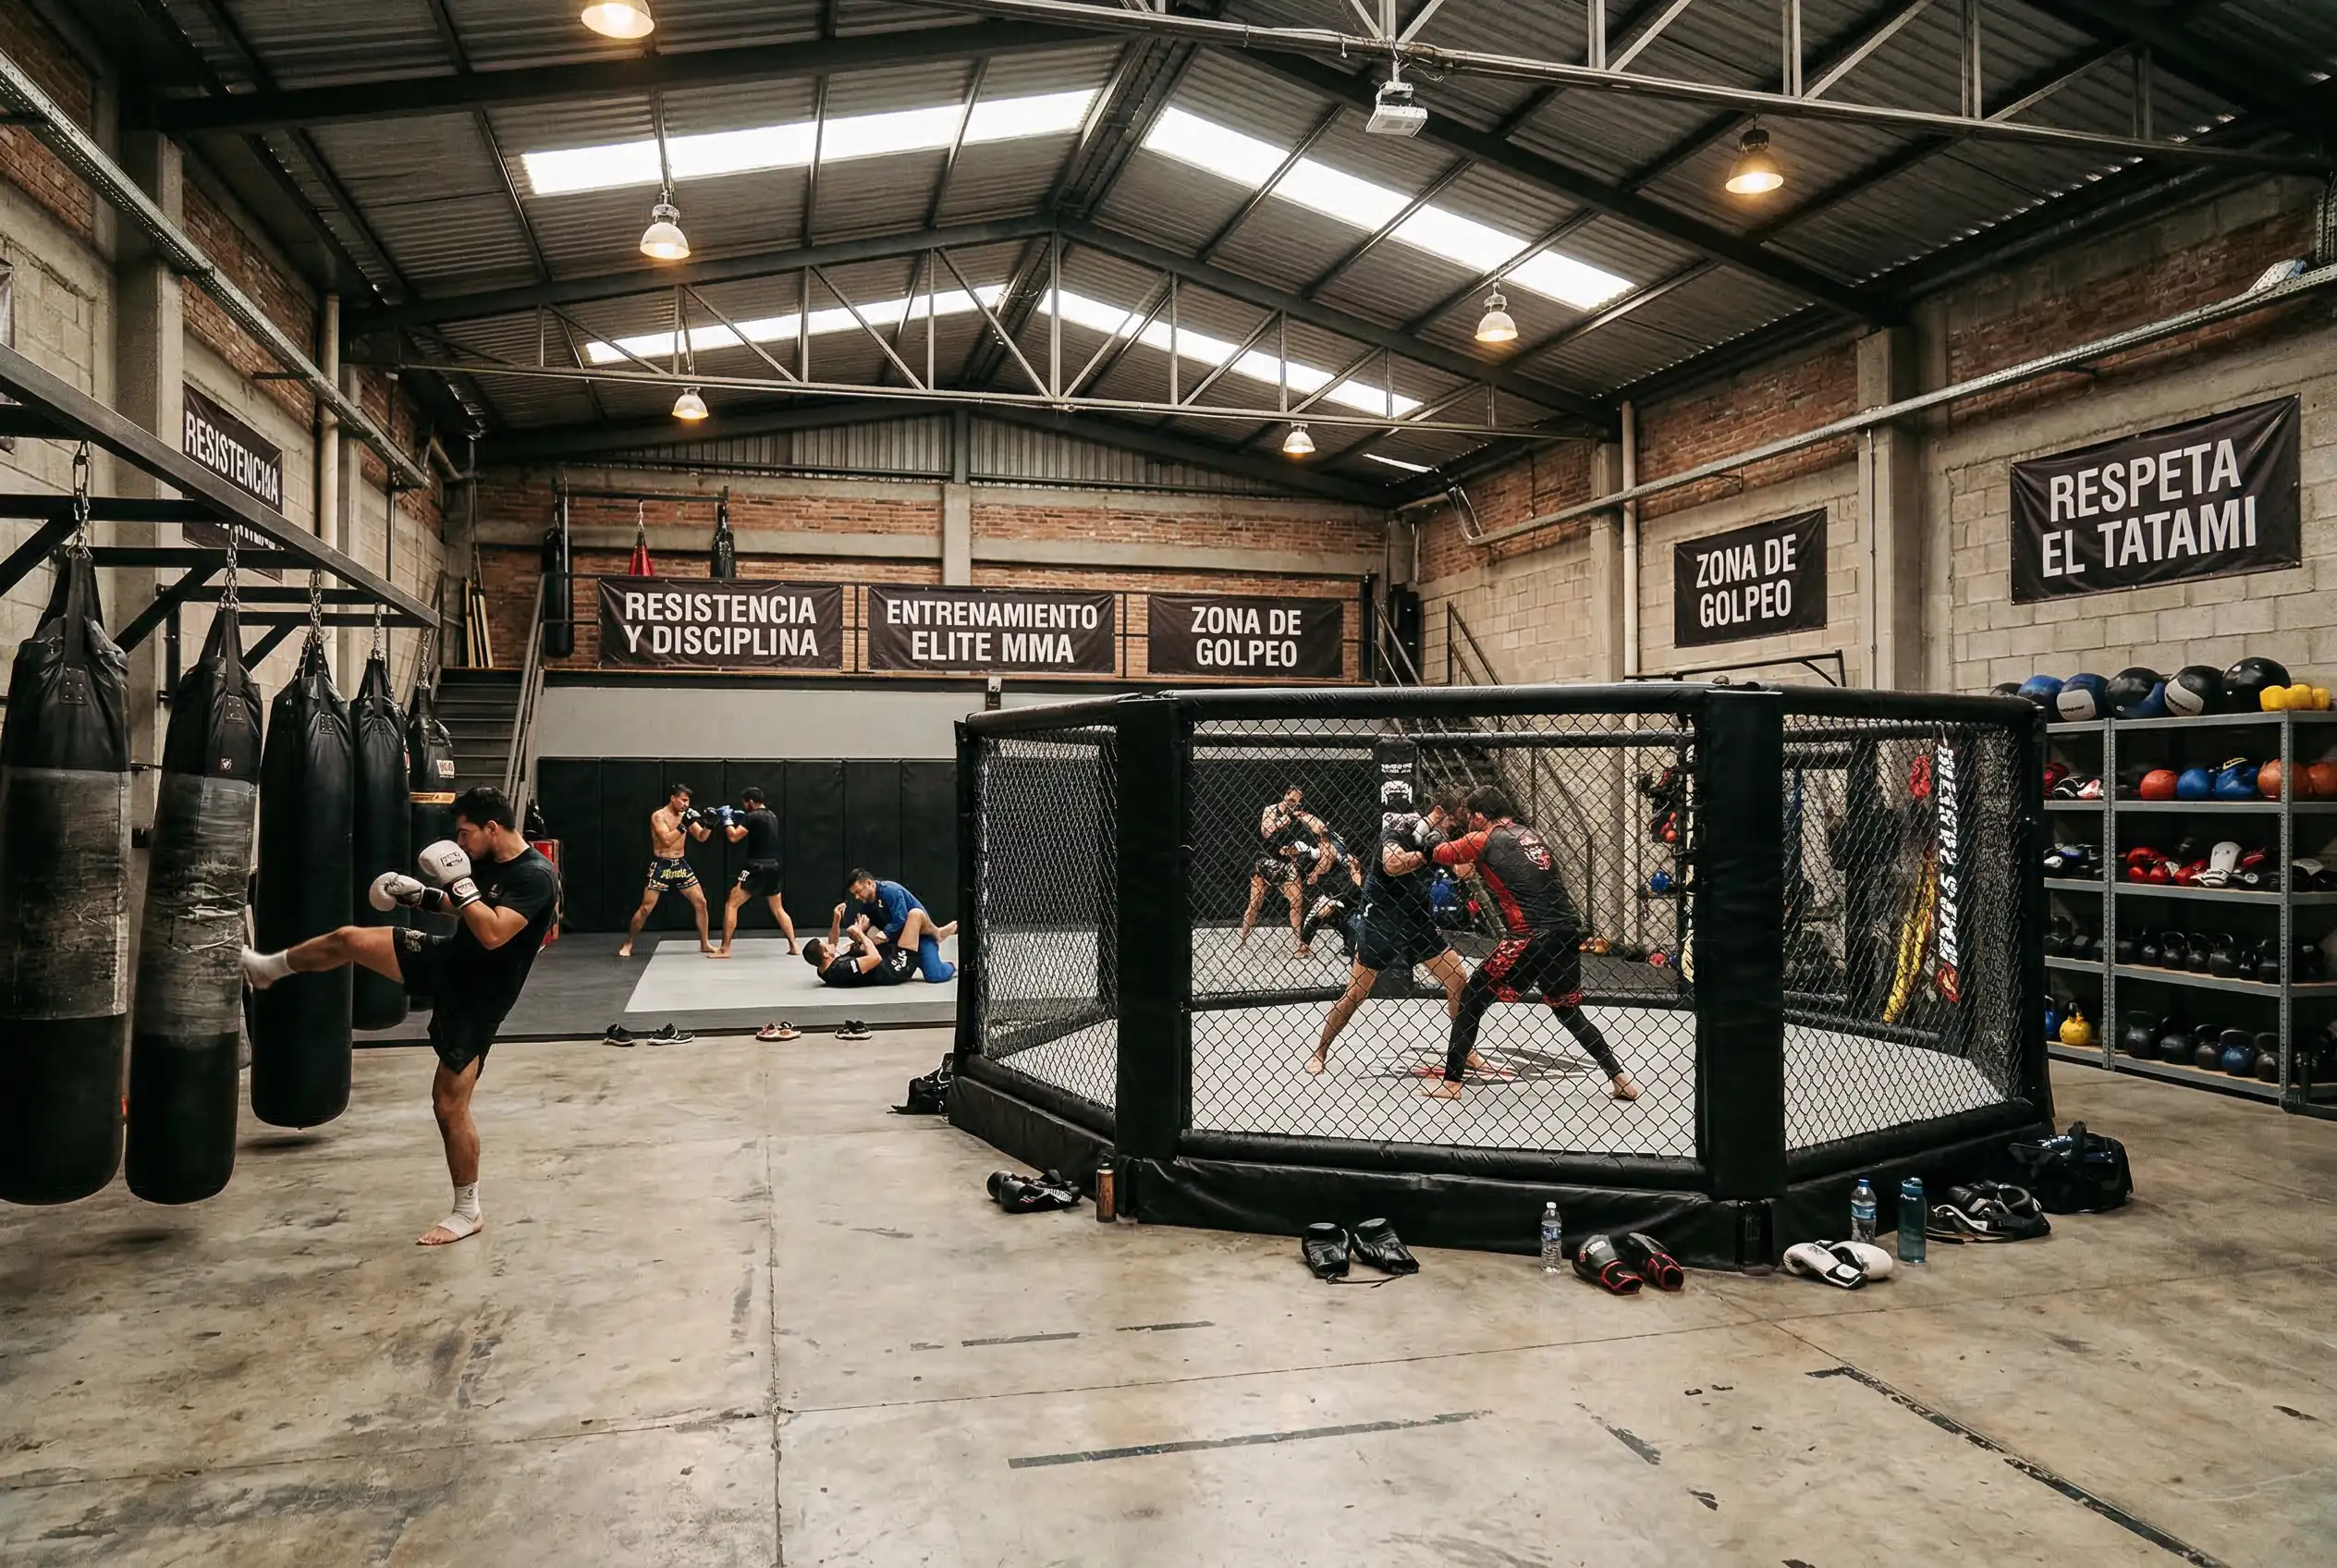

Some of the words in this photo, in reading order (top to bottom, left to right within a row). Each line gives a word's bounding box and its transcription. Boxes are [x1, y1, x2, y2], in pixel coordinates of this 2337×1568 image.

[2049, 438, 2242, 523] RESPETA
[2042, 528, 2086, 578] EL
[2098, 495, 2257, 569] TATAMI
[1695, 544, 1758, 589] ZONA
[1765, 533, 1797, 576] DE
[625, 592, 817, 625] RESISTENCIA
[887, 598, 1098, 630] ENTRENAMIENTO
[1700, 579, 1792, 629] GOLPEO
[1191, 606, 1262, 635] ZONA
[1269, 609, 1302, 636] DE
[623, 625, 643, 654] Y
[653, 626, 819, 656] DISCIPLINA
[912, 631, 992, 662] ELITE
[1001, 632, 1075, 664] MMA
[1196, 638, 1297, 668] GOLPEO
